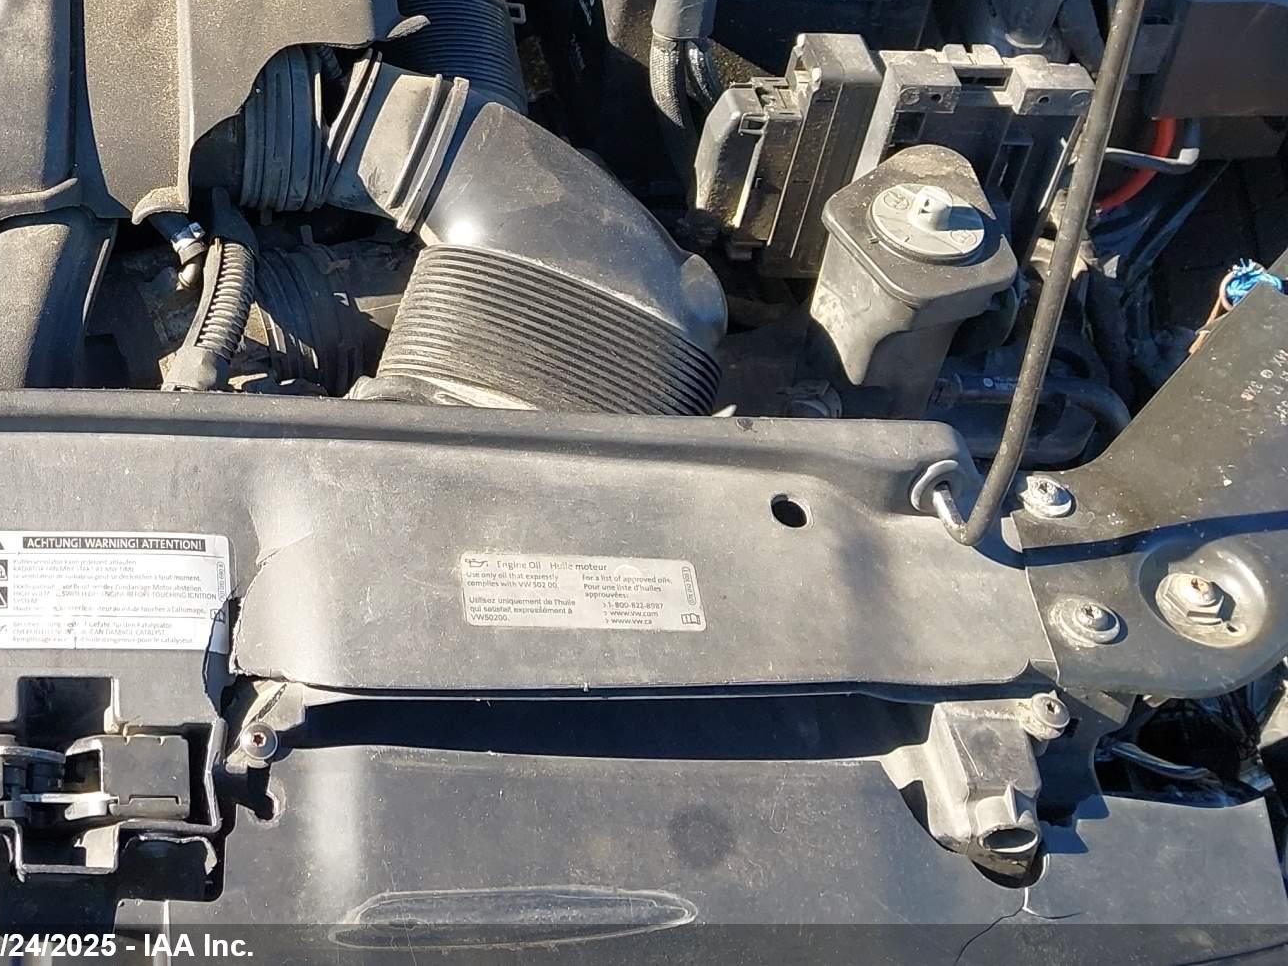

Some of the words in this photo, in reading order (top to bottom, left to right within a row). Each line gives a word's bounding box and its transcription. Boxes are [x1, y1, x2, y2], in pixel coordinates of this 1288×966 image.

[27, 538, 82, 548] ACHTUNG!
[85, 538, 139, 549] WARNING!
[142, 539, 202, 550] ATTENTION!
[497, 561, 526, 570] Engine
[529, 561, 542, 570] Oil
[575, 563, 608, 571] moteur
[467, 580, 499, 588] complies
[623, 576, 656, 584] approved
[497, 597, 541, 606] uniquement
